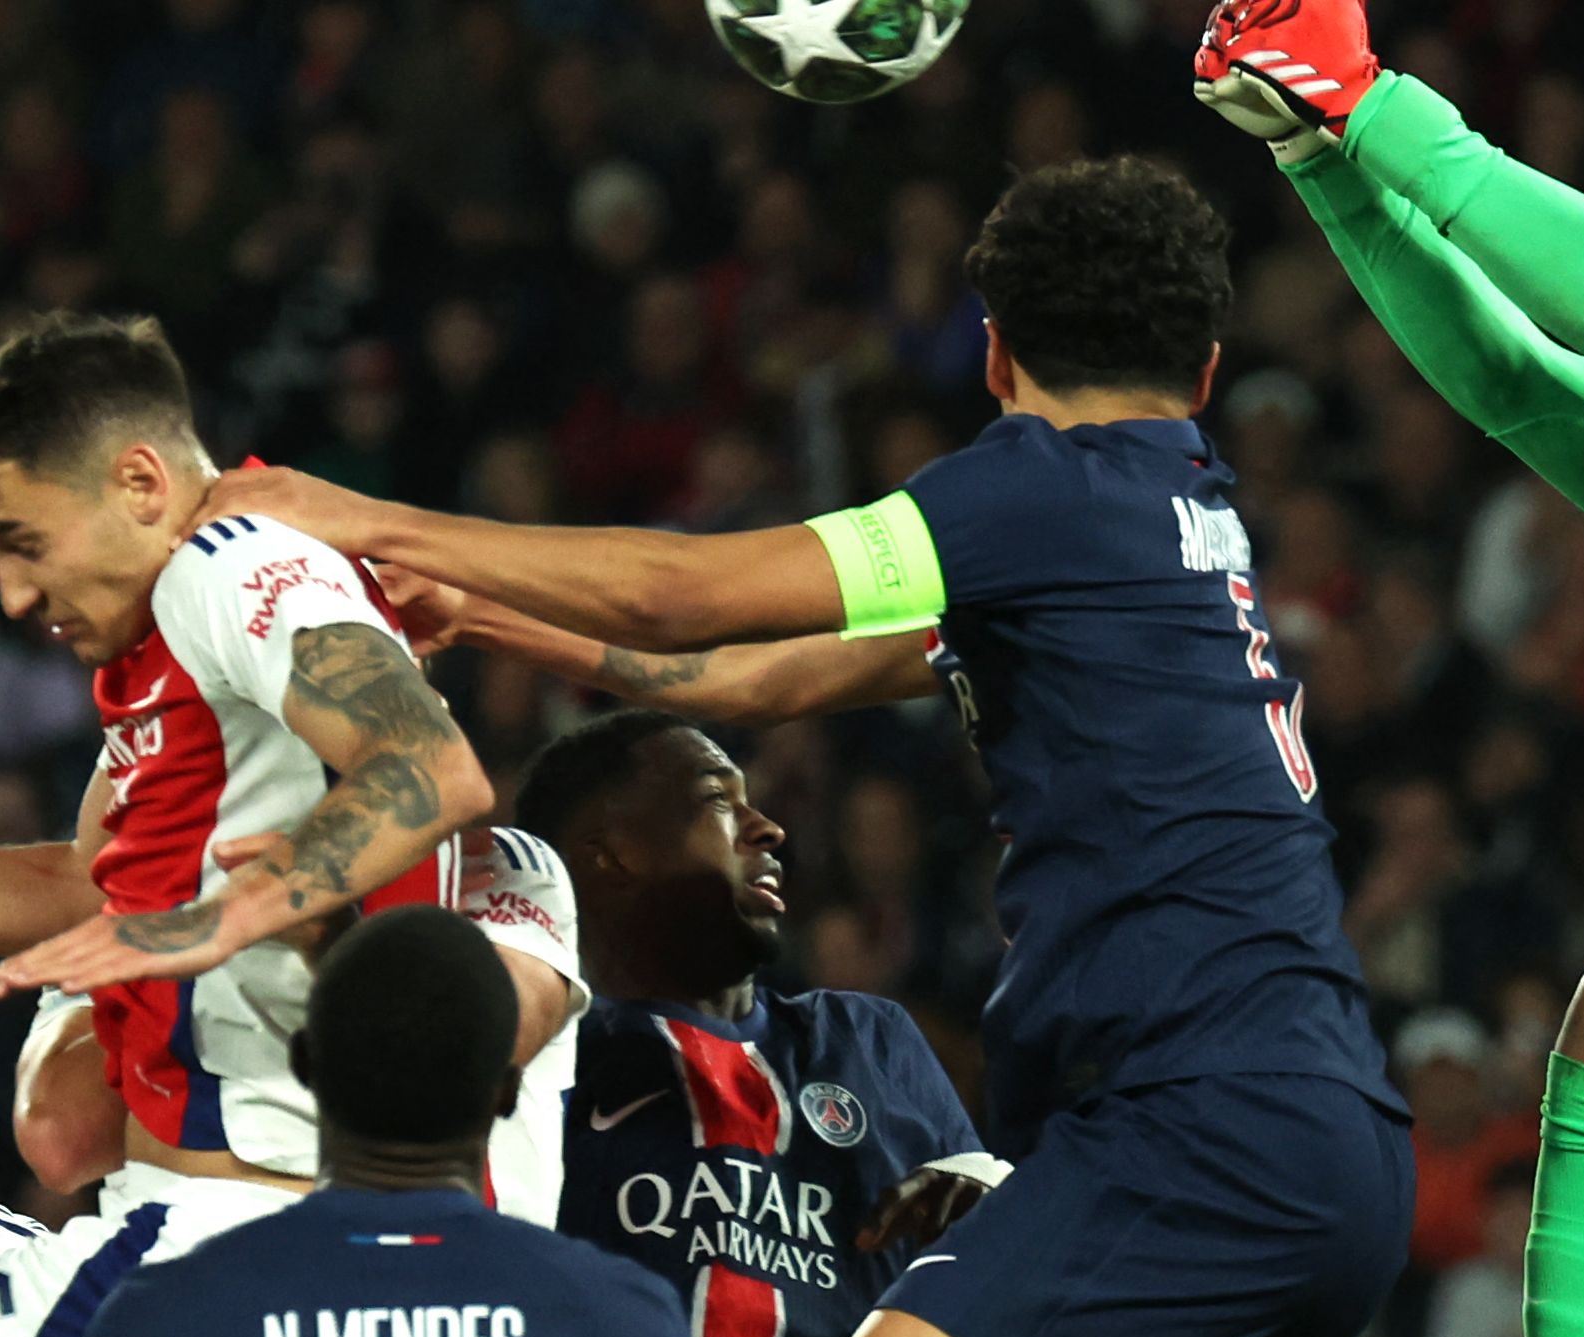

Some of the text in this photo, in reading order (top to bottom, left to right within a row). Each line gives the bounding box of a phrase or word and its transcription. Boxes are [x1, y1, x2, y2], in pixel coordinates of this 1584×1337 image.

[241, 557, 309, 590] VISIT
[617, 1157, 835, 1248] QATAR
[687, 1219, 838, 1290] AIRWAYS
